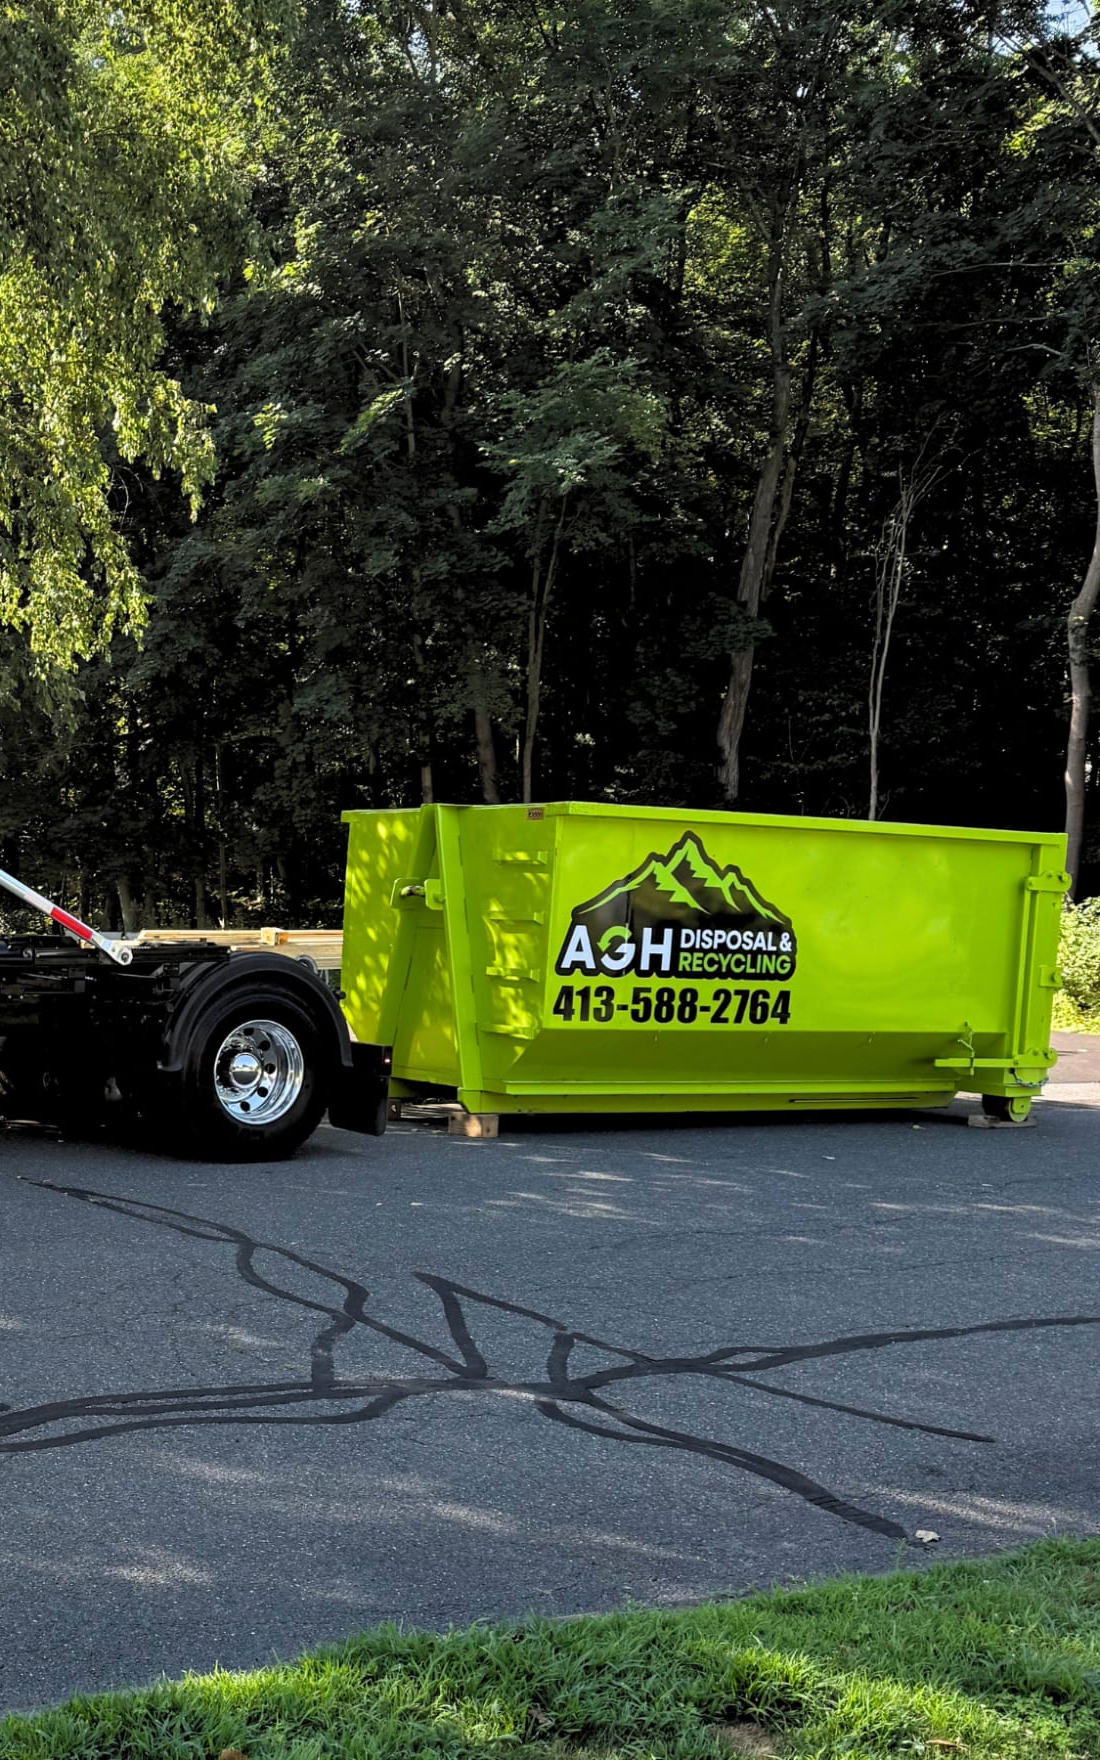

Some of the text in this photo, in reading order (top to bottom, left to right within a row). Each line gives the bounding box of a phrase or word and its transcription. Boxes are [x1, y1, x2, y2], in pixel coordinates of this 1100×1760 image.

[560, 924, 673, 971] AGH
[680, 929, 792, 952] DISPOSAL &
[678, 952, 792, 975] RECYCLING
[553, 985, 791, 1024] 413-588-2764
